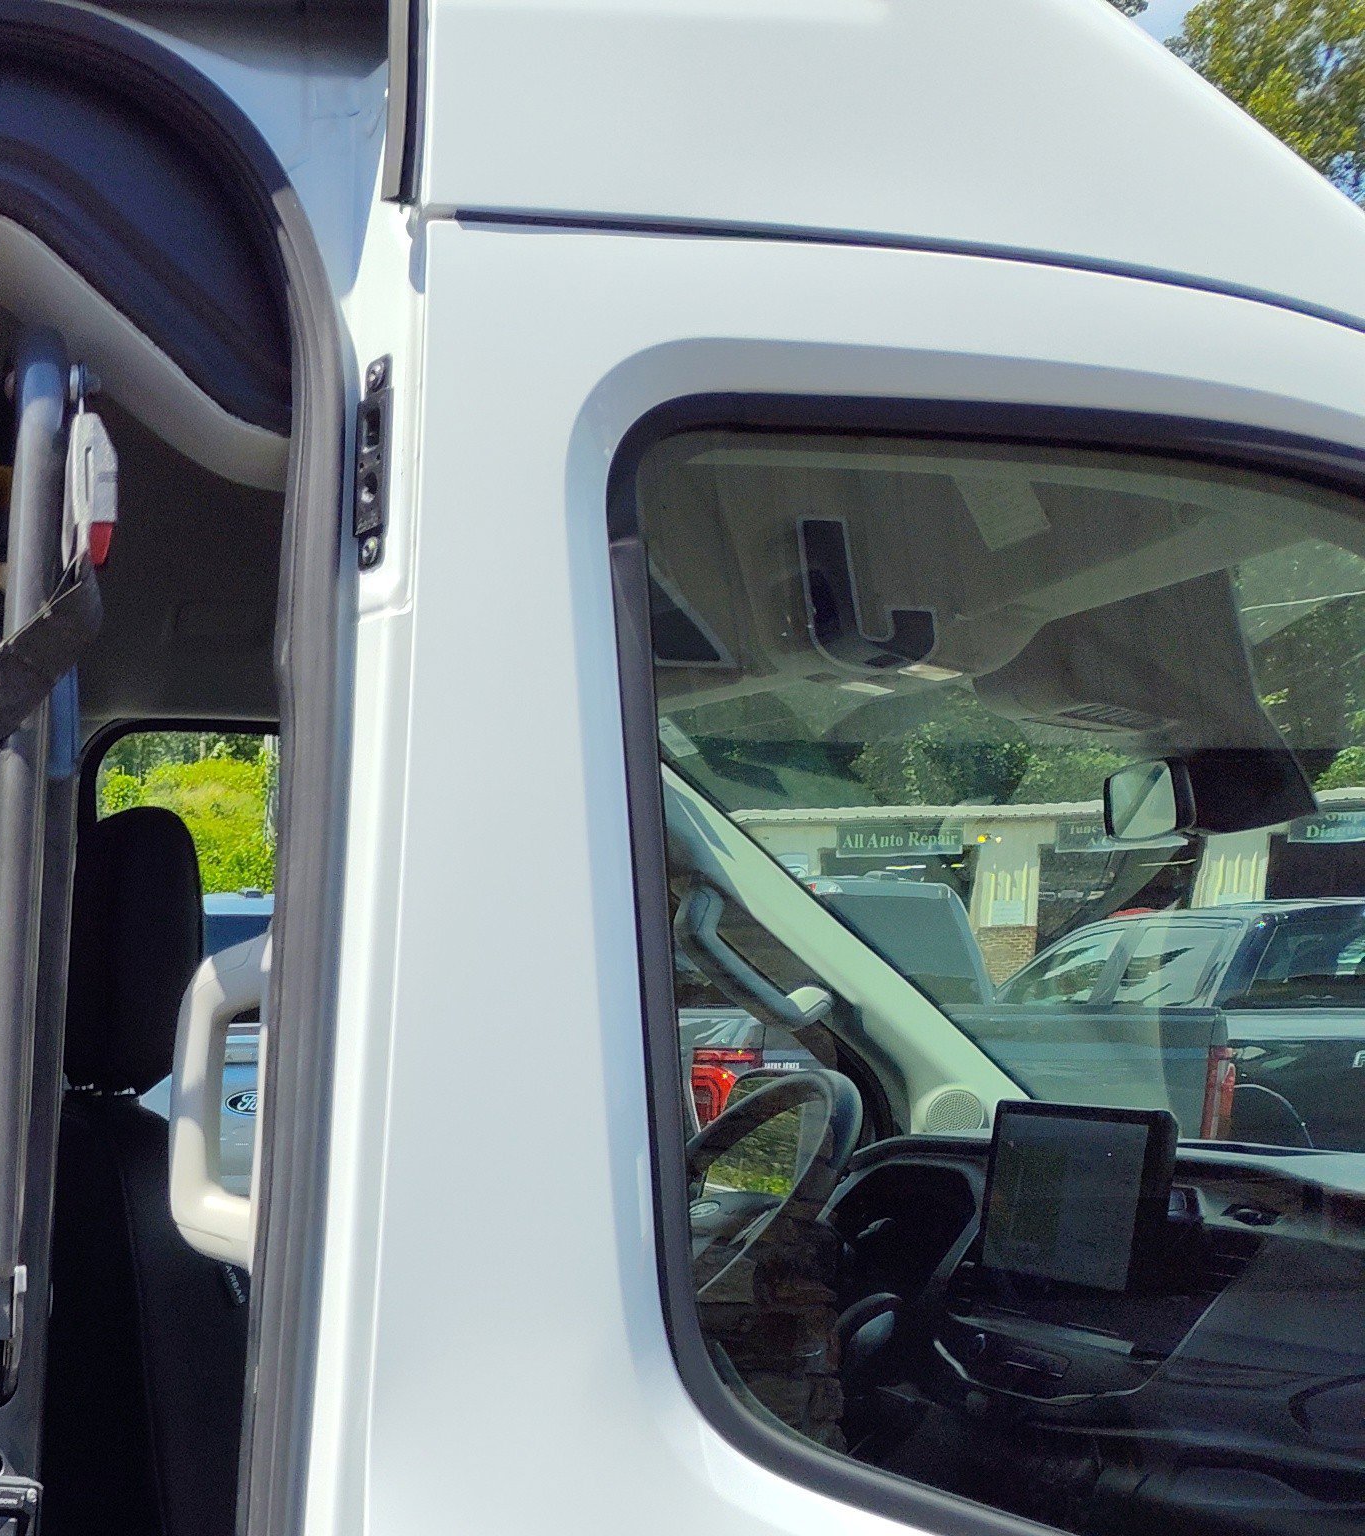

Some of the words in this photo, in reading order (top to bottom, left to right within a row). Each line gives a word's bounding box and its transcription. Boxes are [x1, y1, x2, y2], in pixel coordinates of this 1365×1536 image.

[842, 832, 864, 849] All
[867, 830, 903, 849] Auto
[908, 827, 959, 850] Repair
